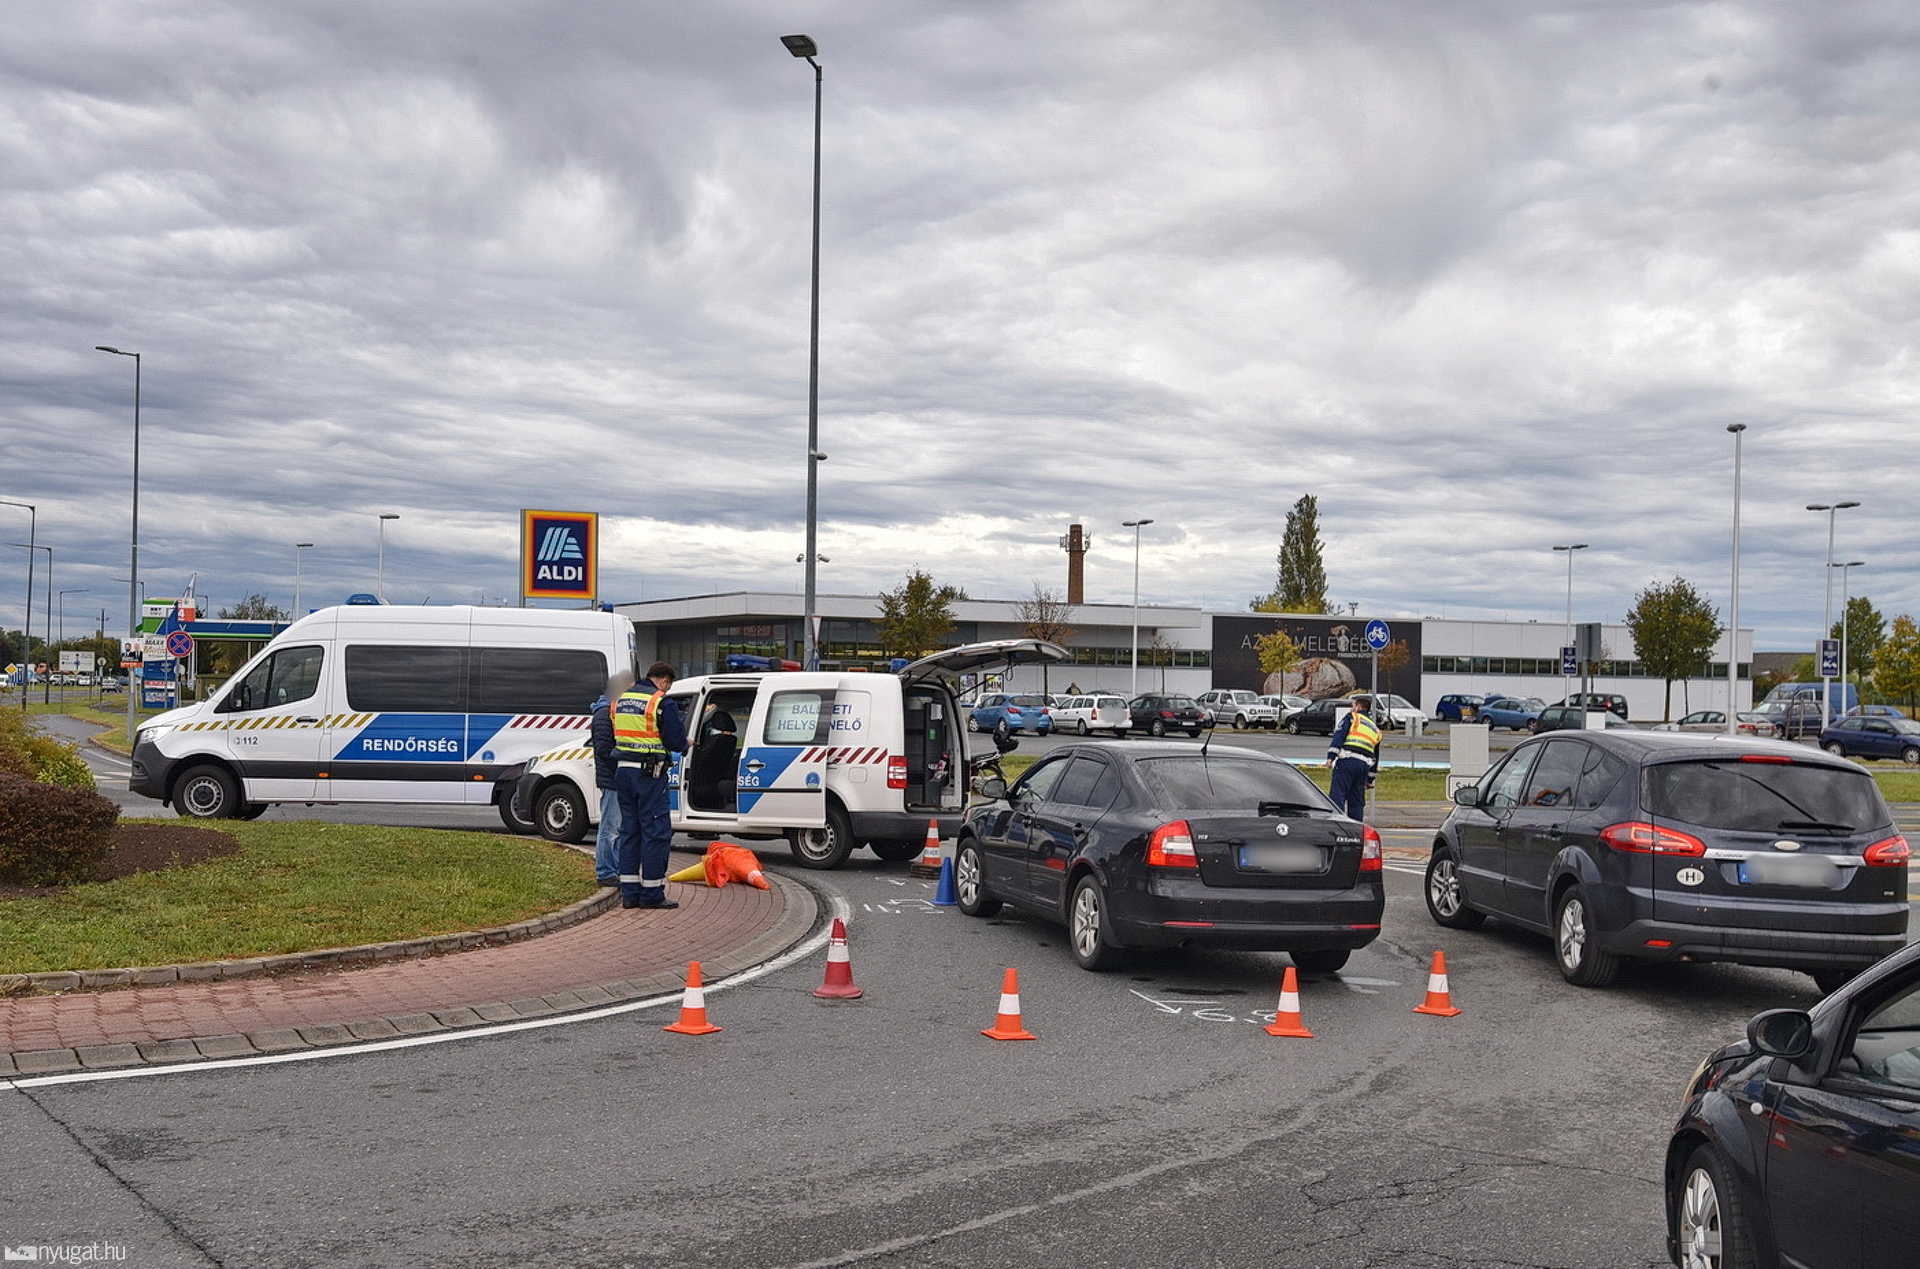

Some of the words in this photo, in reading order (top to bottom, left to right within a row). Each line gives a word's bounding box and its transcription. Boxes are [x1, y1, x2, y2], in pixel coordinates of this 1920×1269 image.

[537, 565, 583, 581] ALDI
[243, 737, 258, 745] 112
[363, 736, 458, 753] RENDŐRSÉG
[1685, 872, 1695, 882] H
